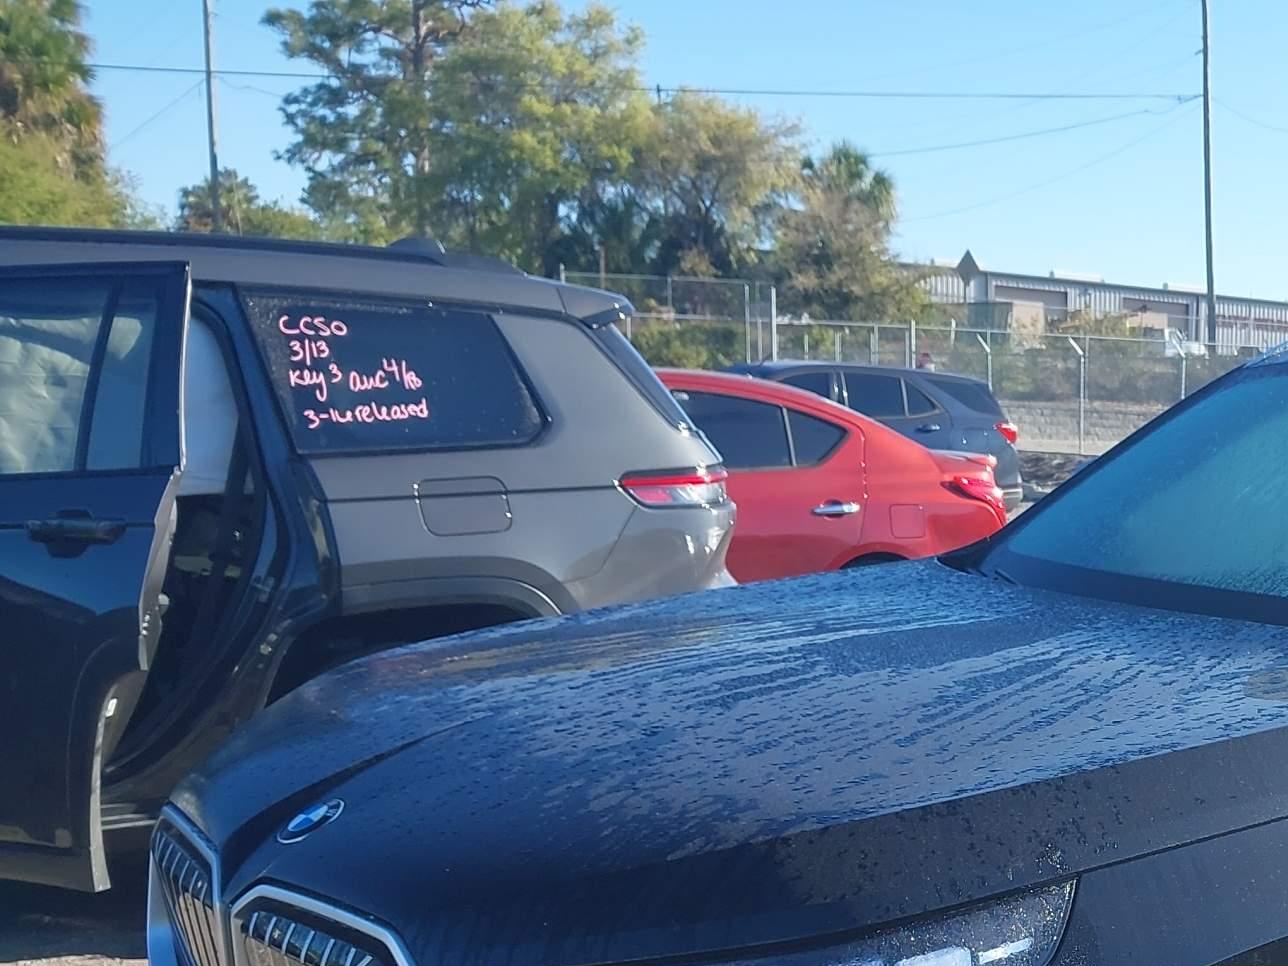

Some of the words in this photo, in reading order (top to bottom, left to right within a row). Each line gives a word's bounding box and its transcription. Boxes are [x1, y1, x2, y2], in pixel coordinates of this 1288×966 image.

[279, 315, 348, 336] CCSO
[289, 338, 330, 366] 3/13
[355, 397, 429, 423] released
